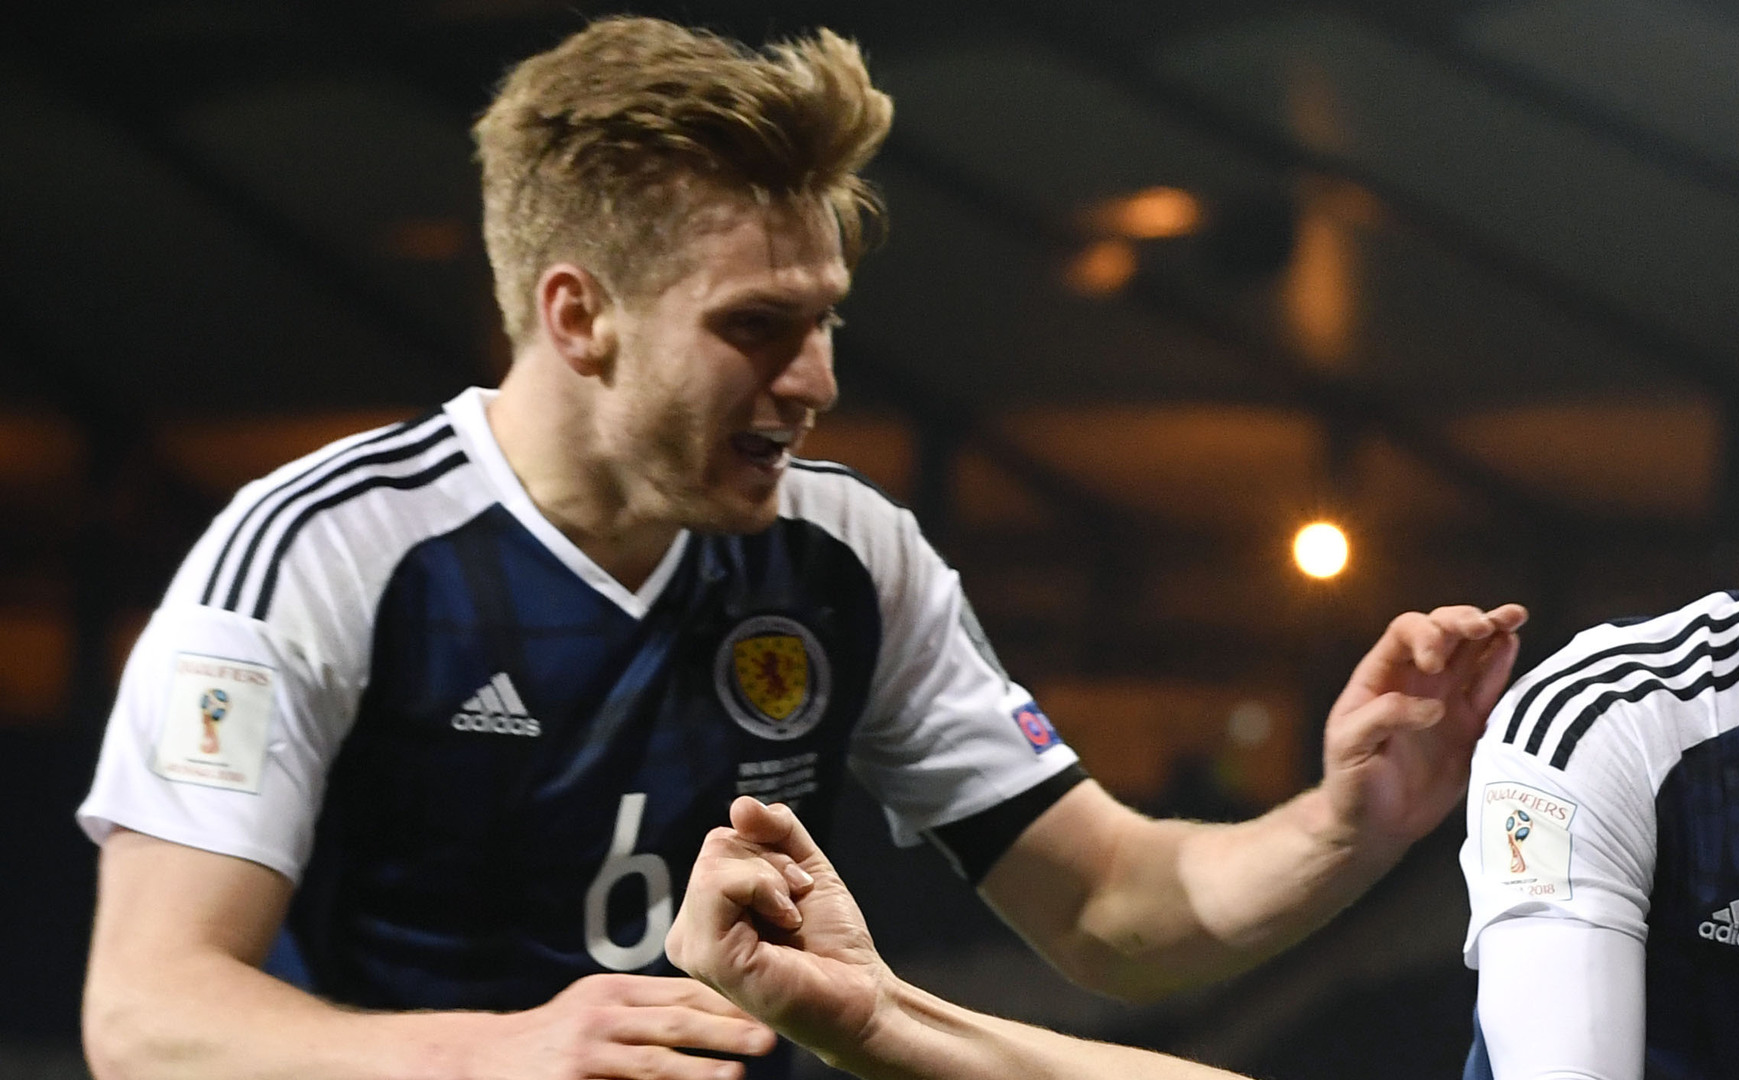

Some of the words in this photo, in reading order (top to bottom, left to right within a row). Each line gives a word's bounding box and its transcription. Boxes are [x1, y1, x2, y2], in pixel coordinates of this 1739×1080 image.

[451, 712, 541, 737] adidas
[1486, 788, 1567, 821] QUALIFIERS
[584, 792, 673, 971] 6
